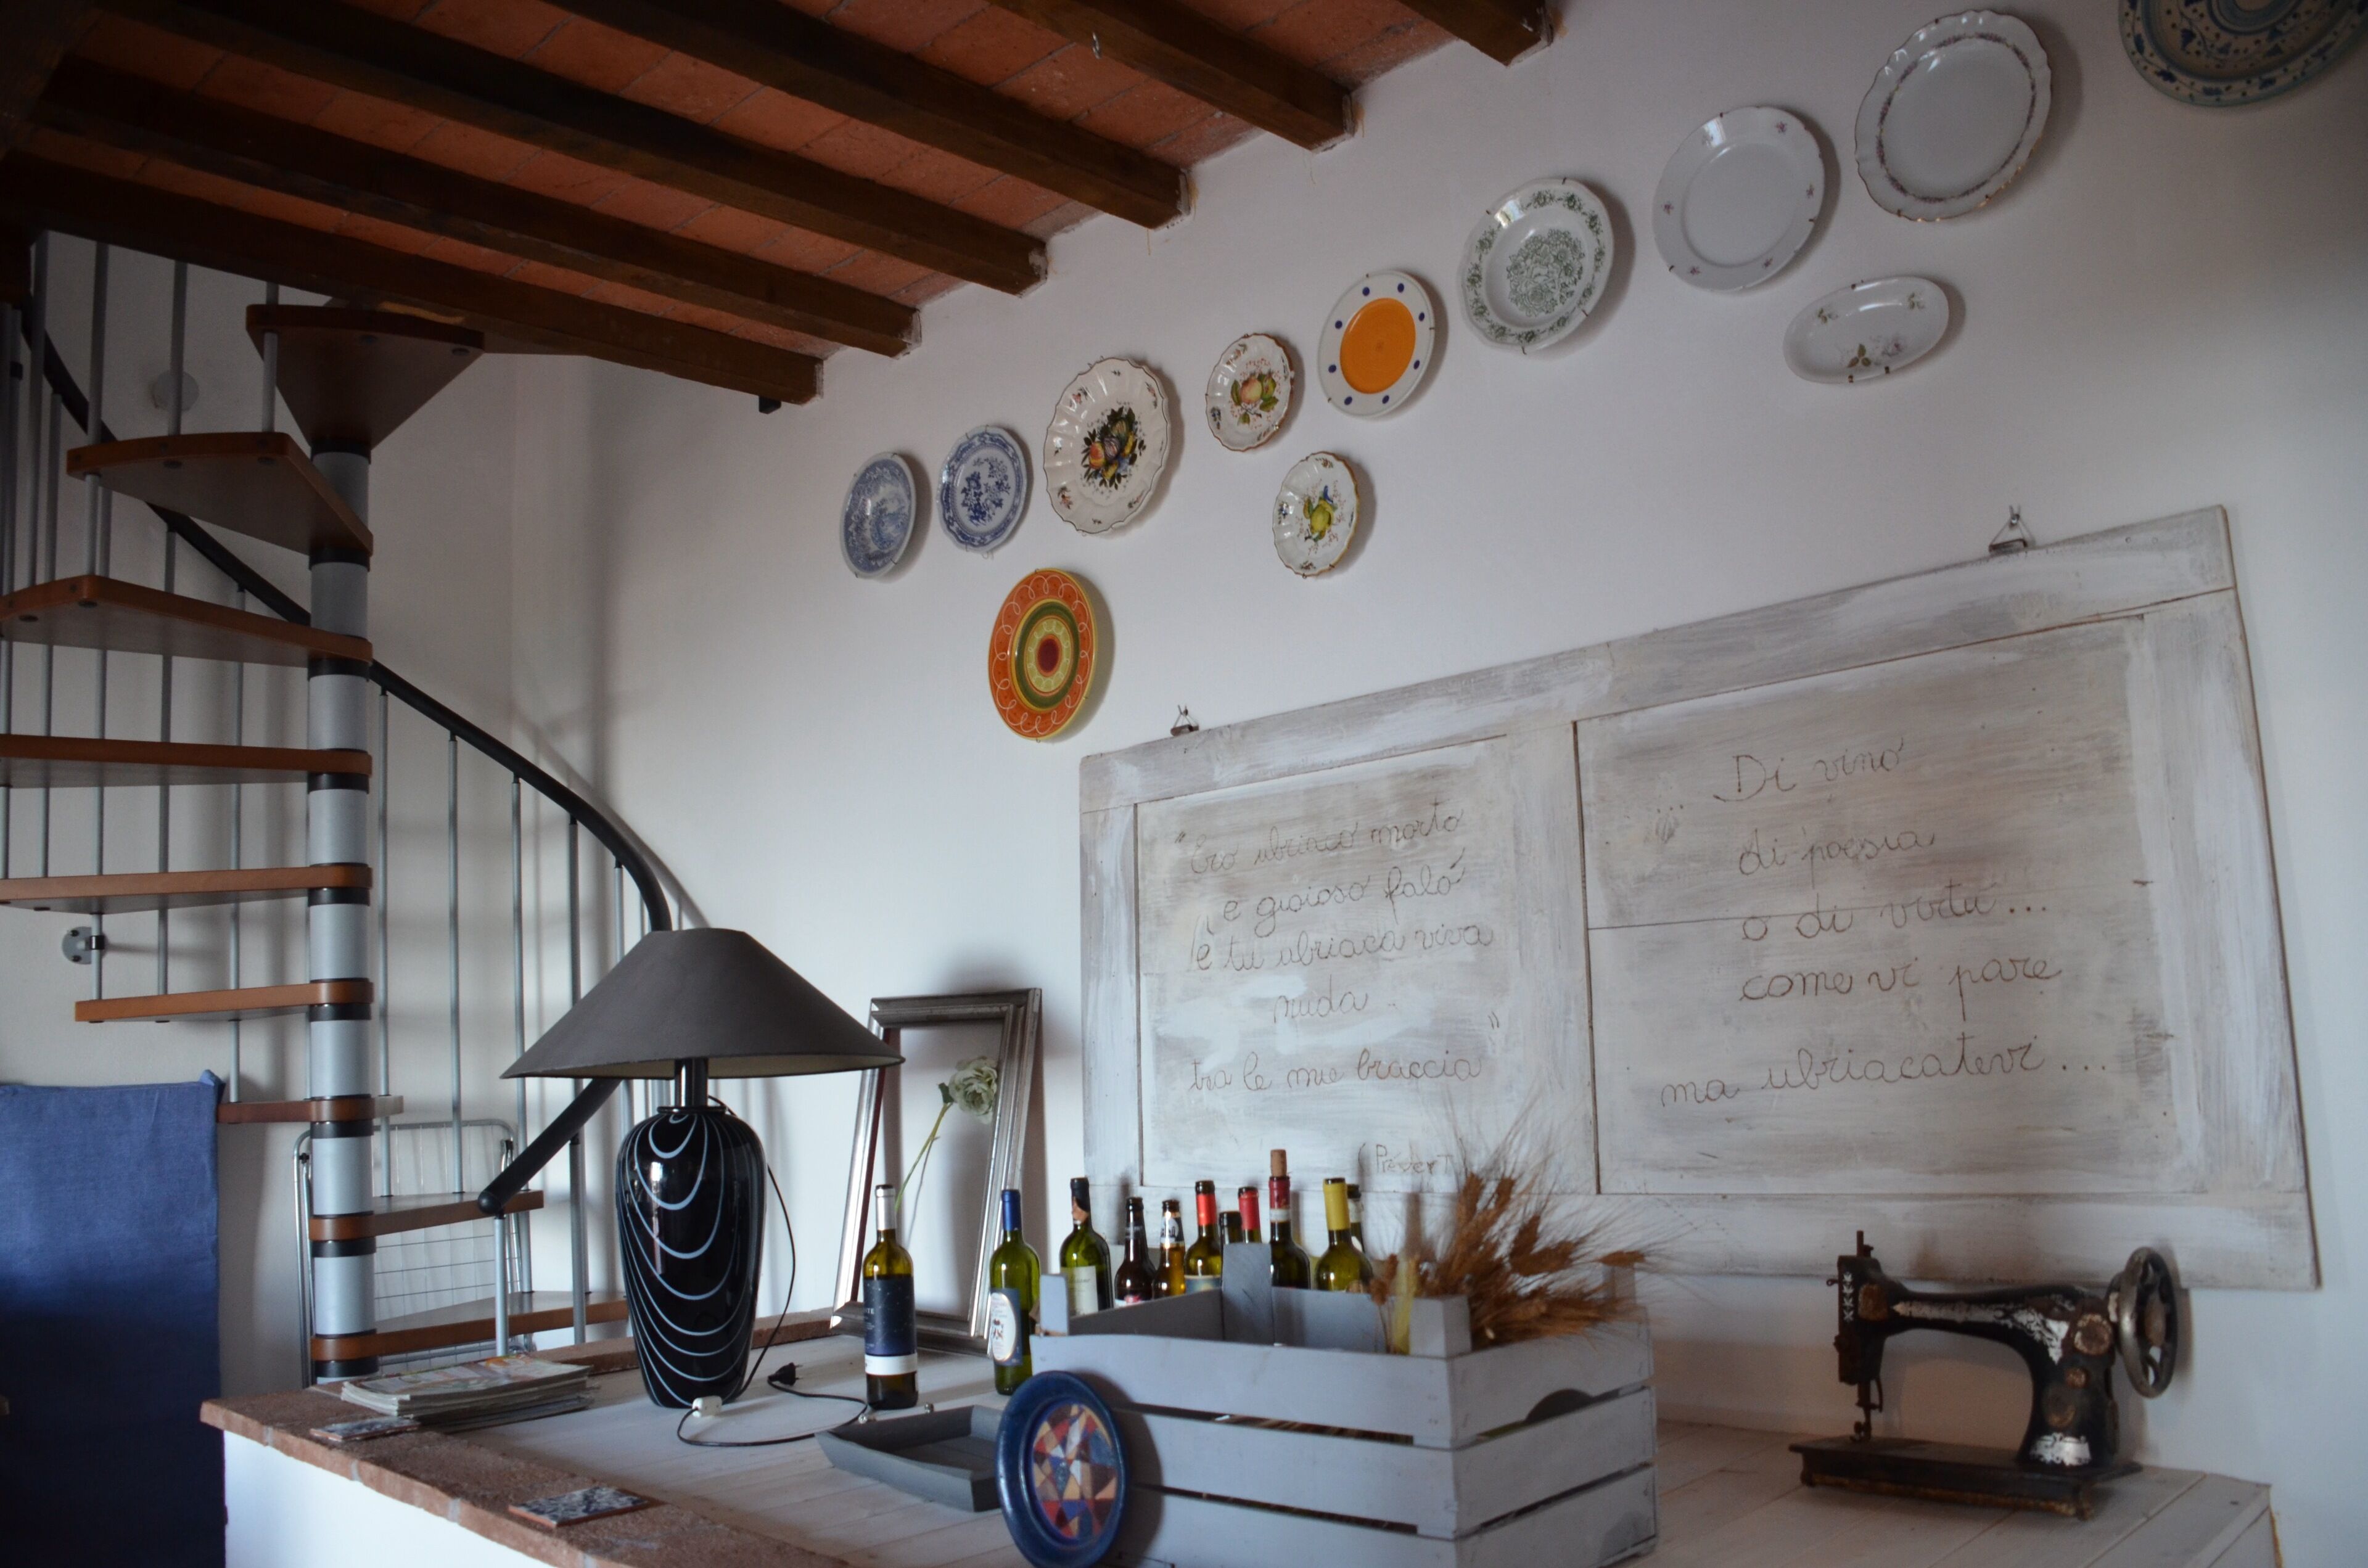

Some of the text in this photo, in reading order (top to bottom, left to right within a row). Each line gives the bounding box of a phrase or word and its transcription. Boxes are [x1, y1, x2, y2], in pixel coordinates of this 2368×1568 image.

[1712, 754, 1797, 803] Di
[1814, 738, 1904, 782] vino
[1370, 798, 1465, 845] morto
[1739, 827, 1786, 875] di
[1223, 900, 1241, 922] e
[1741, 916, 1768, 941] o
[1796, 892, 1852, 938] di
[1223, 935, 1265, 971] tu
[1275, 930, 1406, 967] ubriaca
[1415, 923, 1494, 949] viva
[1273, 973, 1369, 1024] nuda
[1739, 957, 2062, 1022] come vi pare
[1243, 1051, 1273, 1091] le
[1356, 1048, 1481, 1082] braccia
[1660, 1078, 1741, 1107] ma
